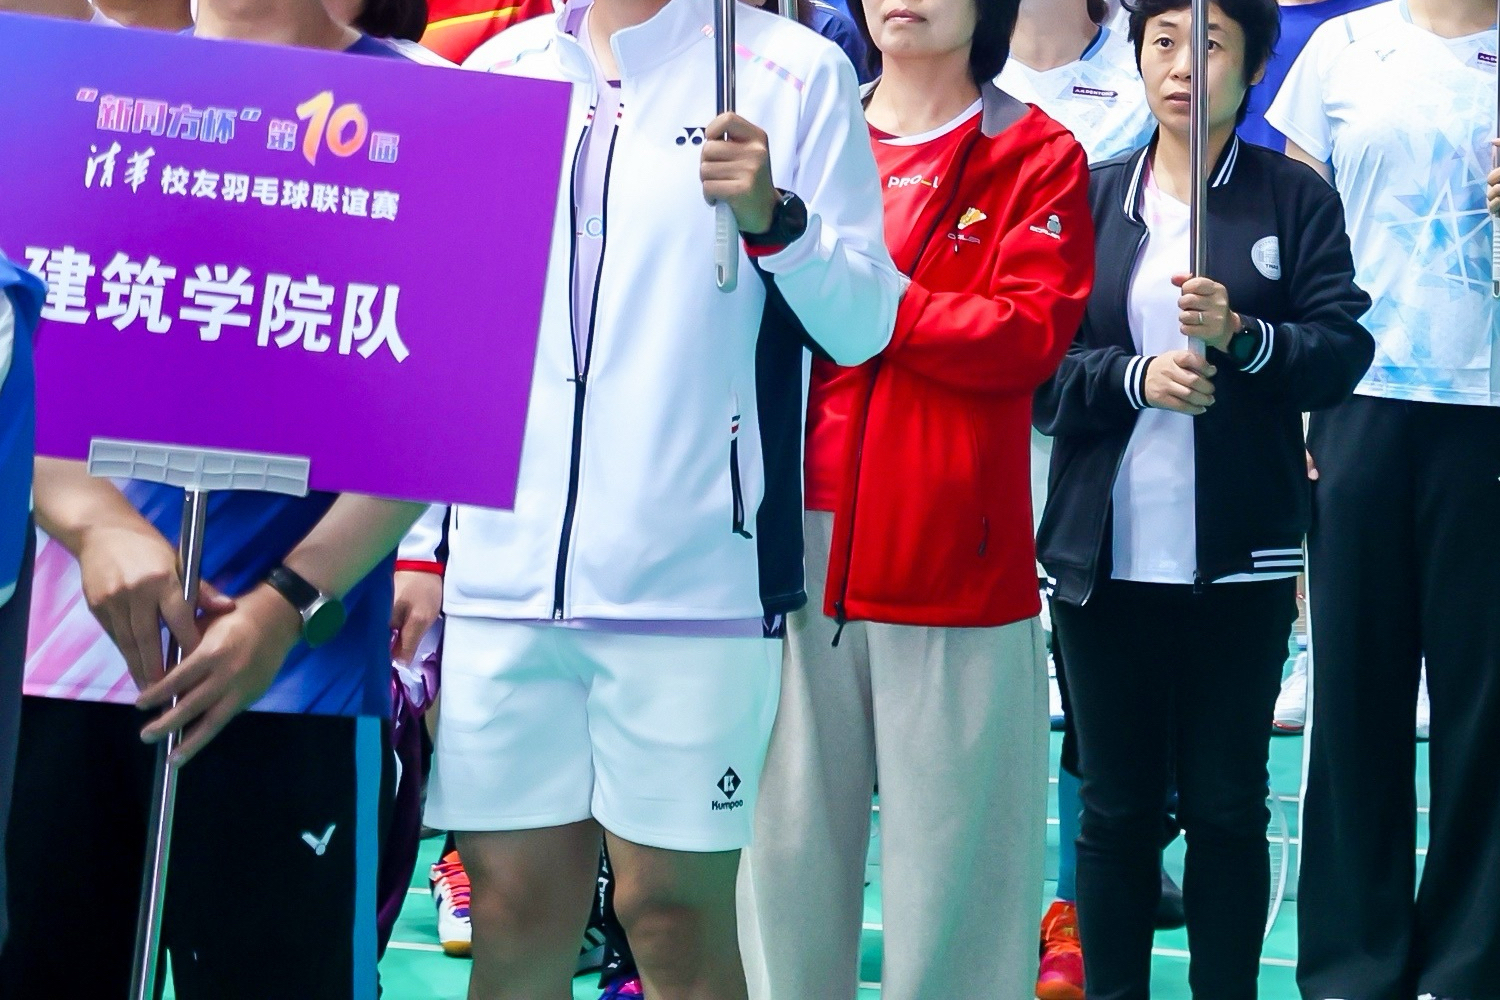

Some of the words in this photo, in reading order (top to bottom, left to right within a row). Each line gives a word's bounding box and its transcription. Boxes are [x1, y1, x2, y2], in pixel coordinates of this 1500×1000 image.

[24, 246, 410, 363] 建筑学院队
[711, 799, 744, 811] Kumpoo
